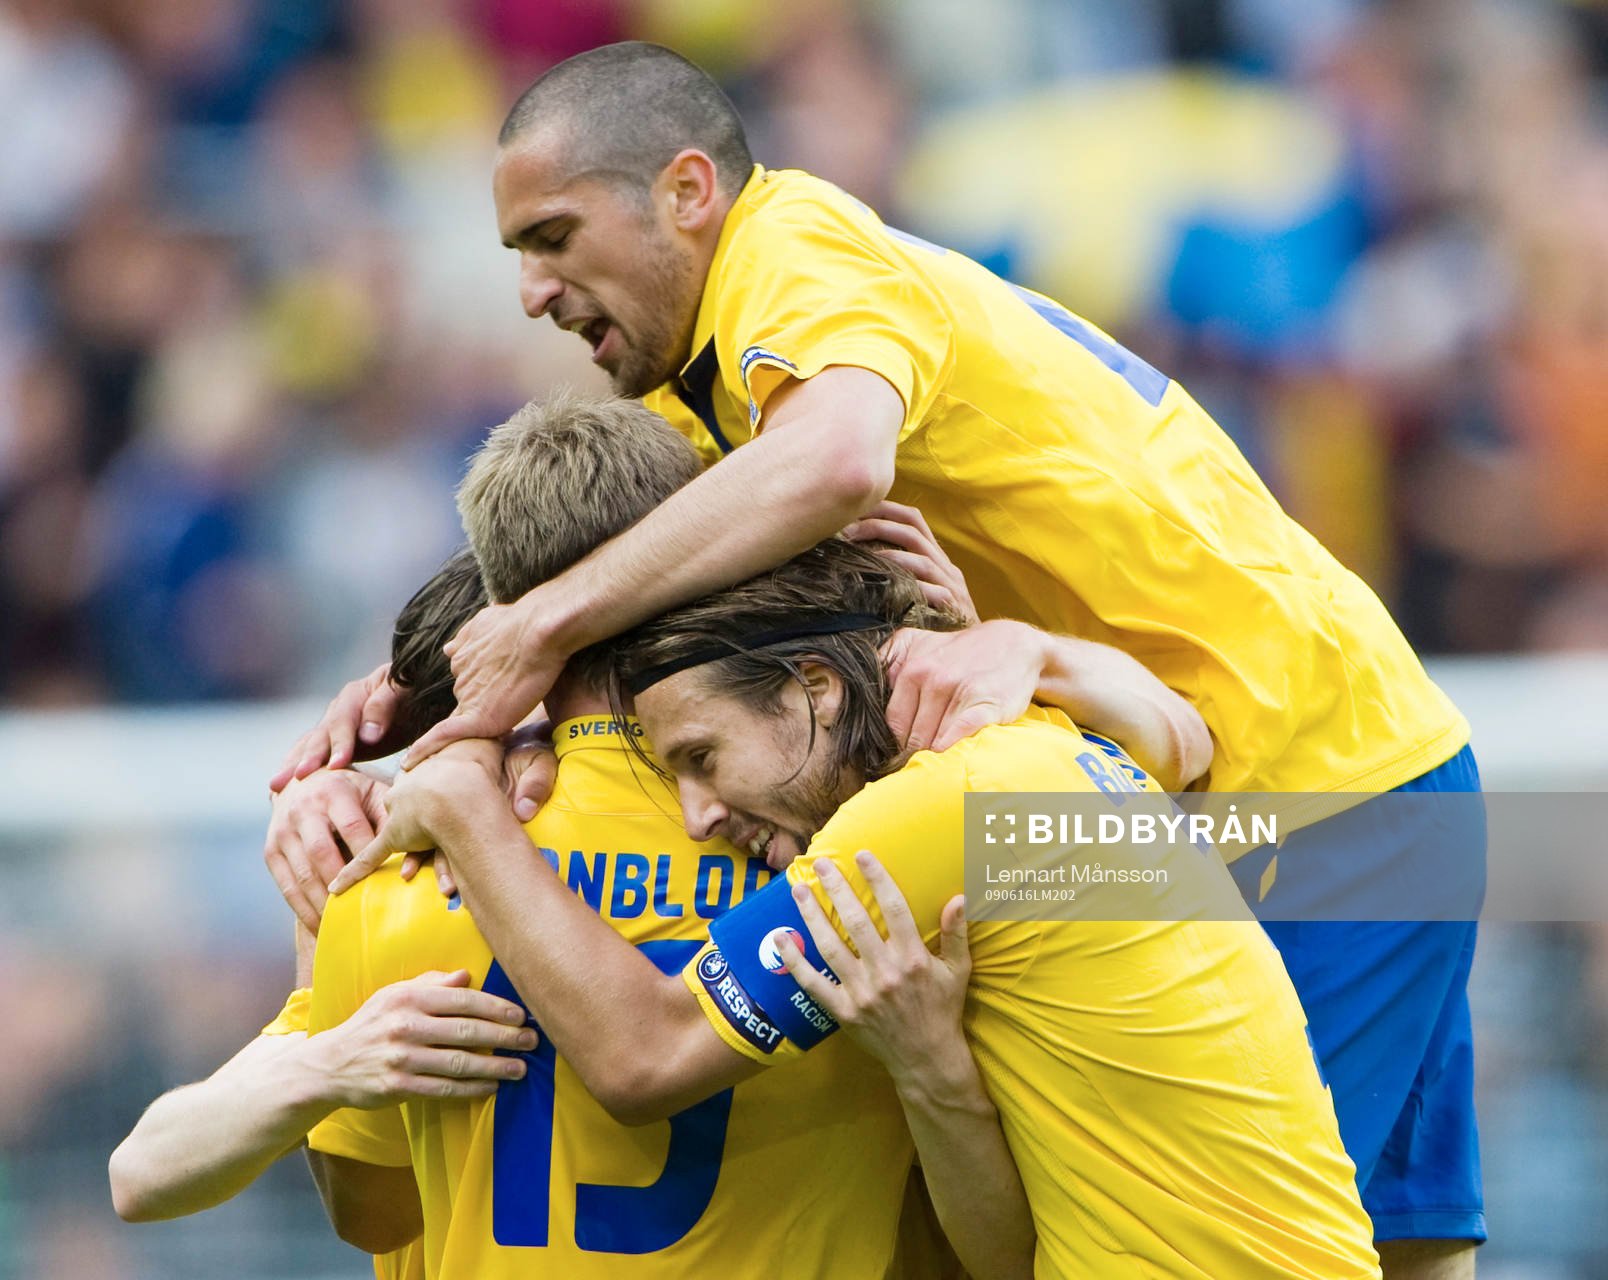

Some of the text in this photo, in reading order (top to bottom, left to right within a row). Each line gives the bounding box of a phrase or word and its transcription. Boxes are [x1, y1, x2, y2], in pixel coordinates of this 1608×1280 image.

[568, 720, 645, 739] SVERG
[716, 975, 781, 1045] RESPECT
[790, 990, 833, 1033] RACISM
